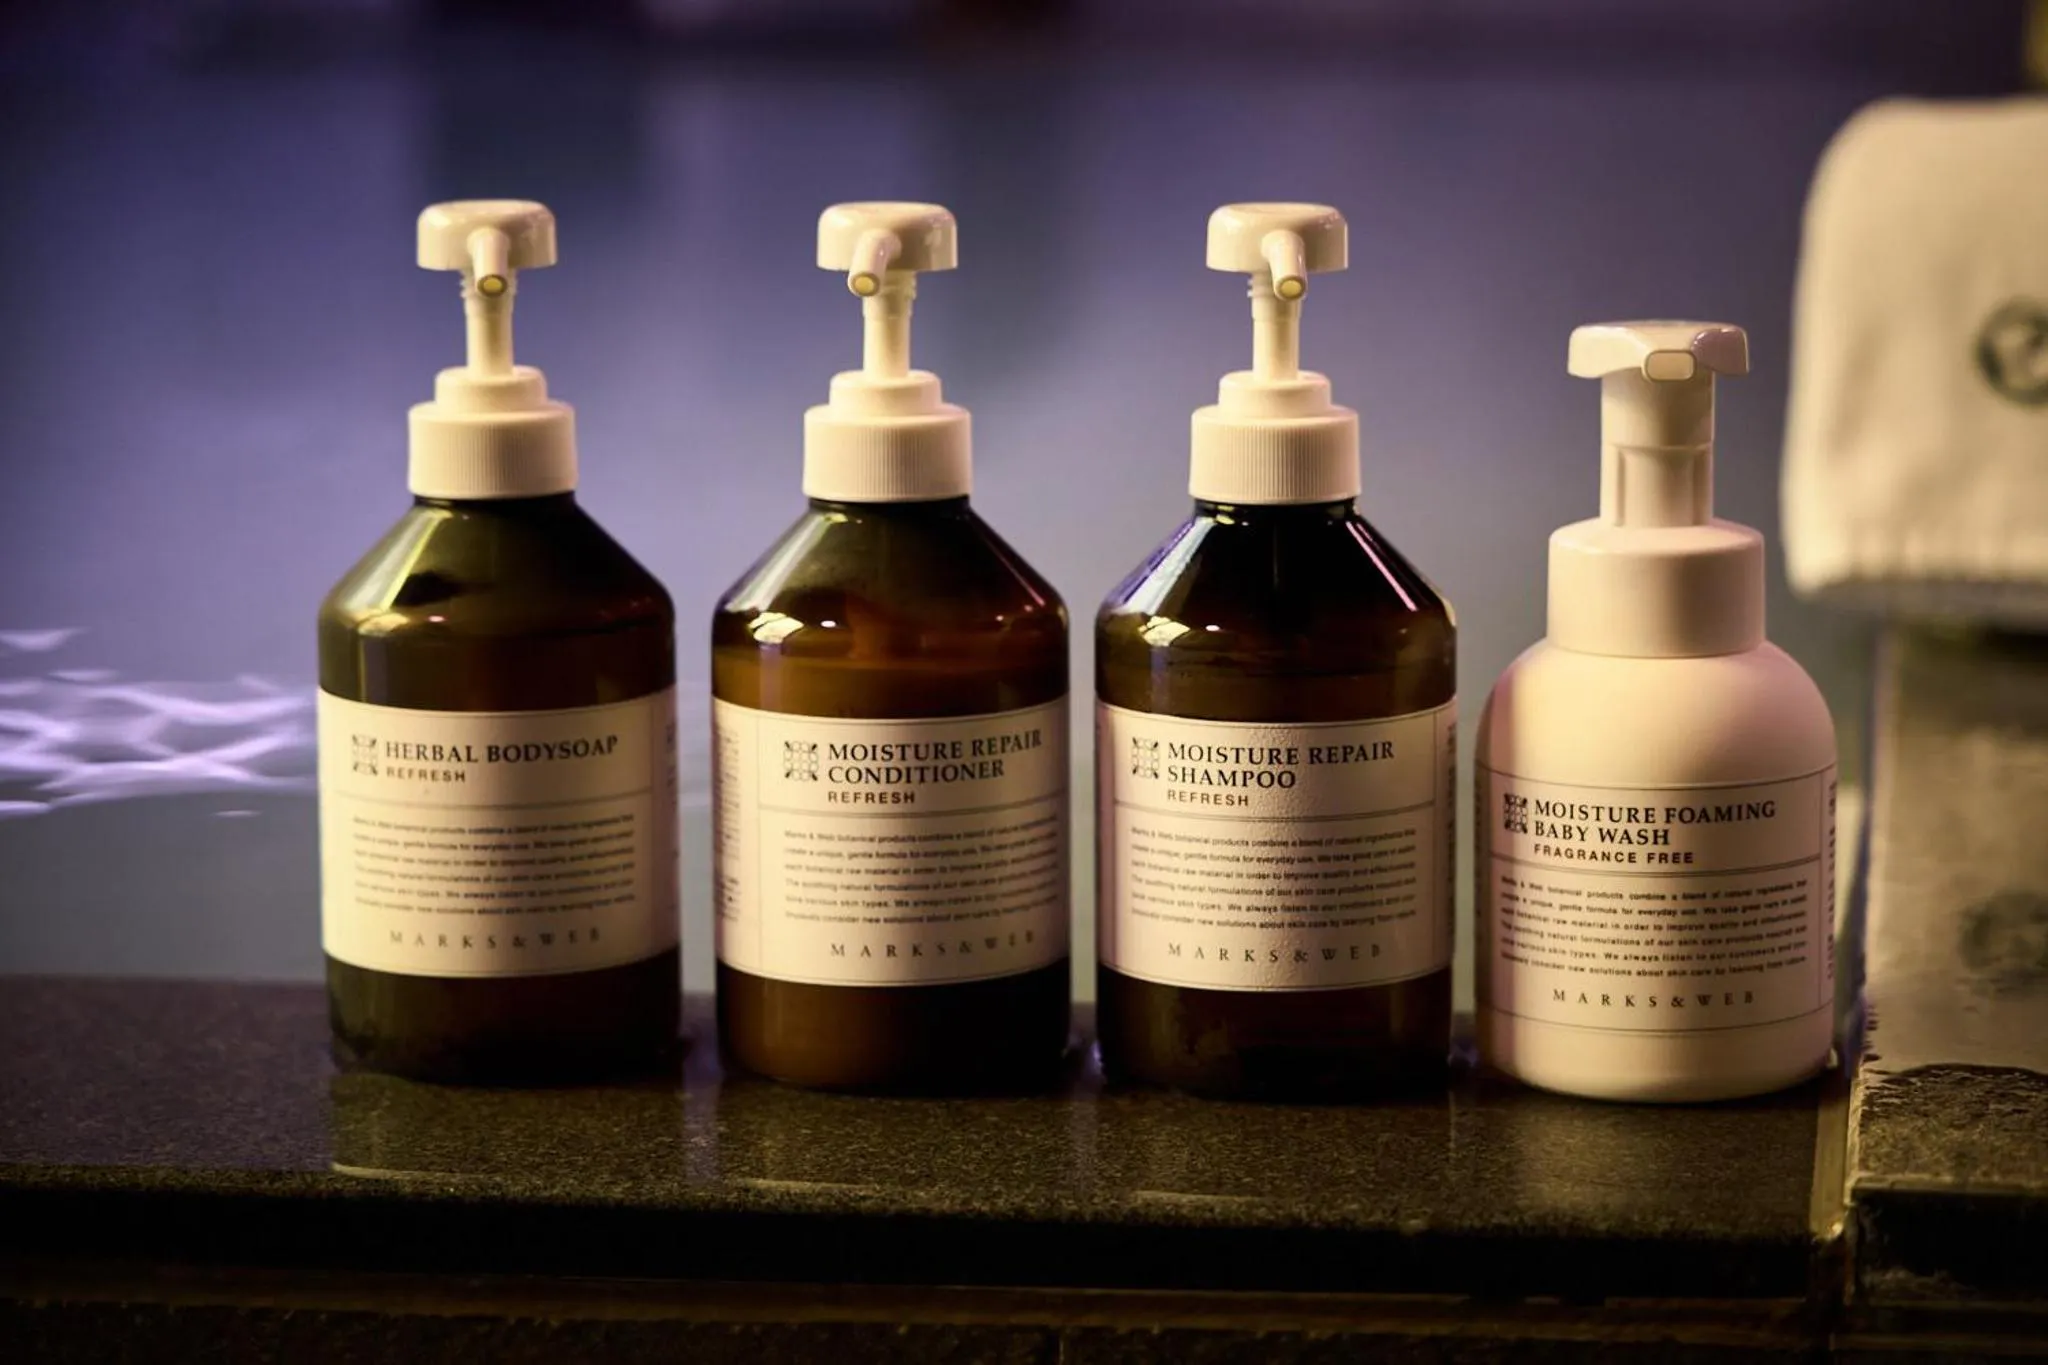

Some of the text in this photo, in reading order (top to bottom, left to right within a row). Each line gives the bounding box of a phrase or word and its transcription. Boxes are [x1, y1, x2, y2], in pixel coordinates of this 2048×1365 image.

[386, 735, 618, 764] HERBAL BODYSOAP
[828, 729, 1042, 762] MOISTURE REPAIR
[1168, 741, 1395, 765] MOISTURE REPAIR
[386, 765, 466, 783] REFRESH
[828, 759, 1005, 784] CONDITIONER
[1168, 765, 1297, 789] SHAMPOO
[828, 790, 915, 804] REFRESH
[1168, 789, 1249, 806] REFRESH
[1534, 800, 1776, 825] MOISTURE FOAMING
[1534, 820, 1670, 846] BABY WASH
[1534, 843, 1694, 864] FRAGRANCE FREE
